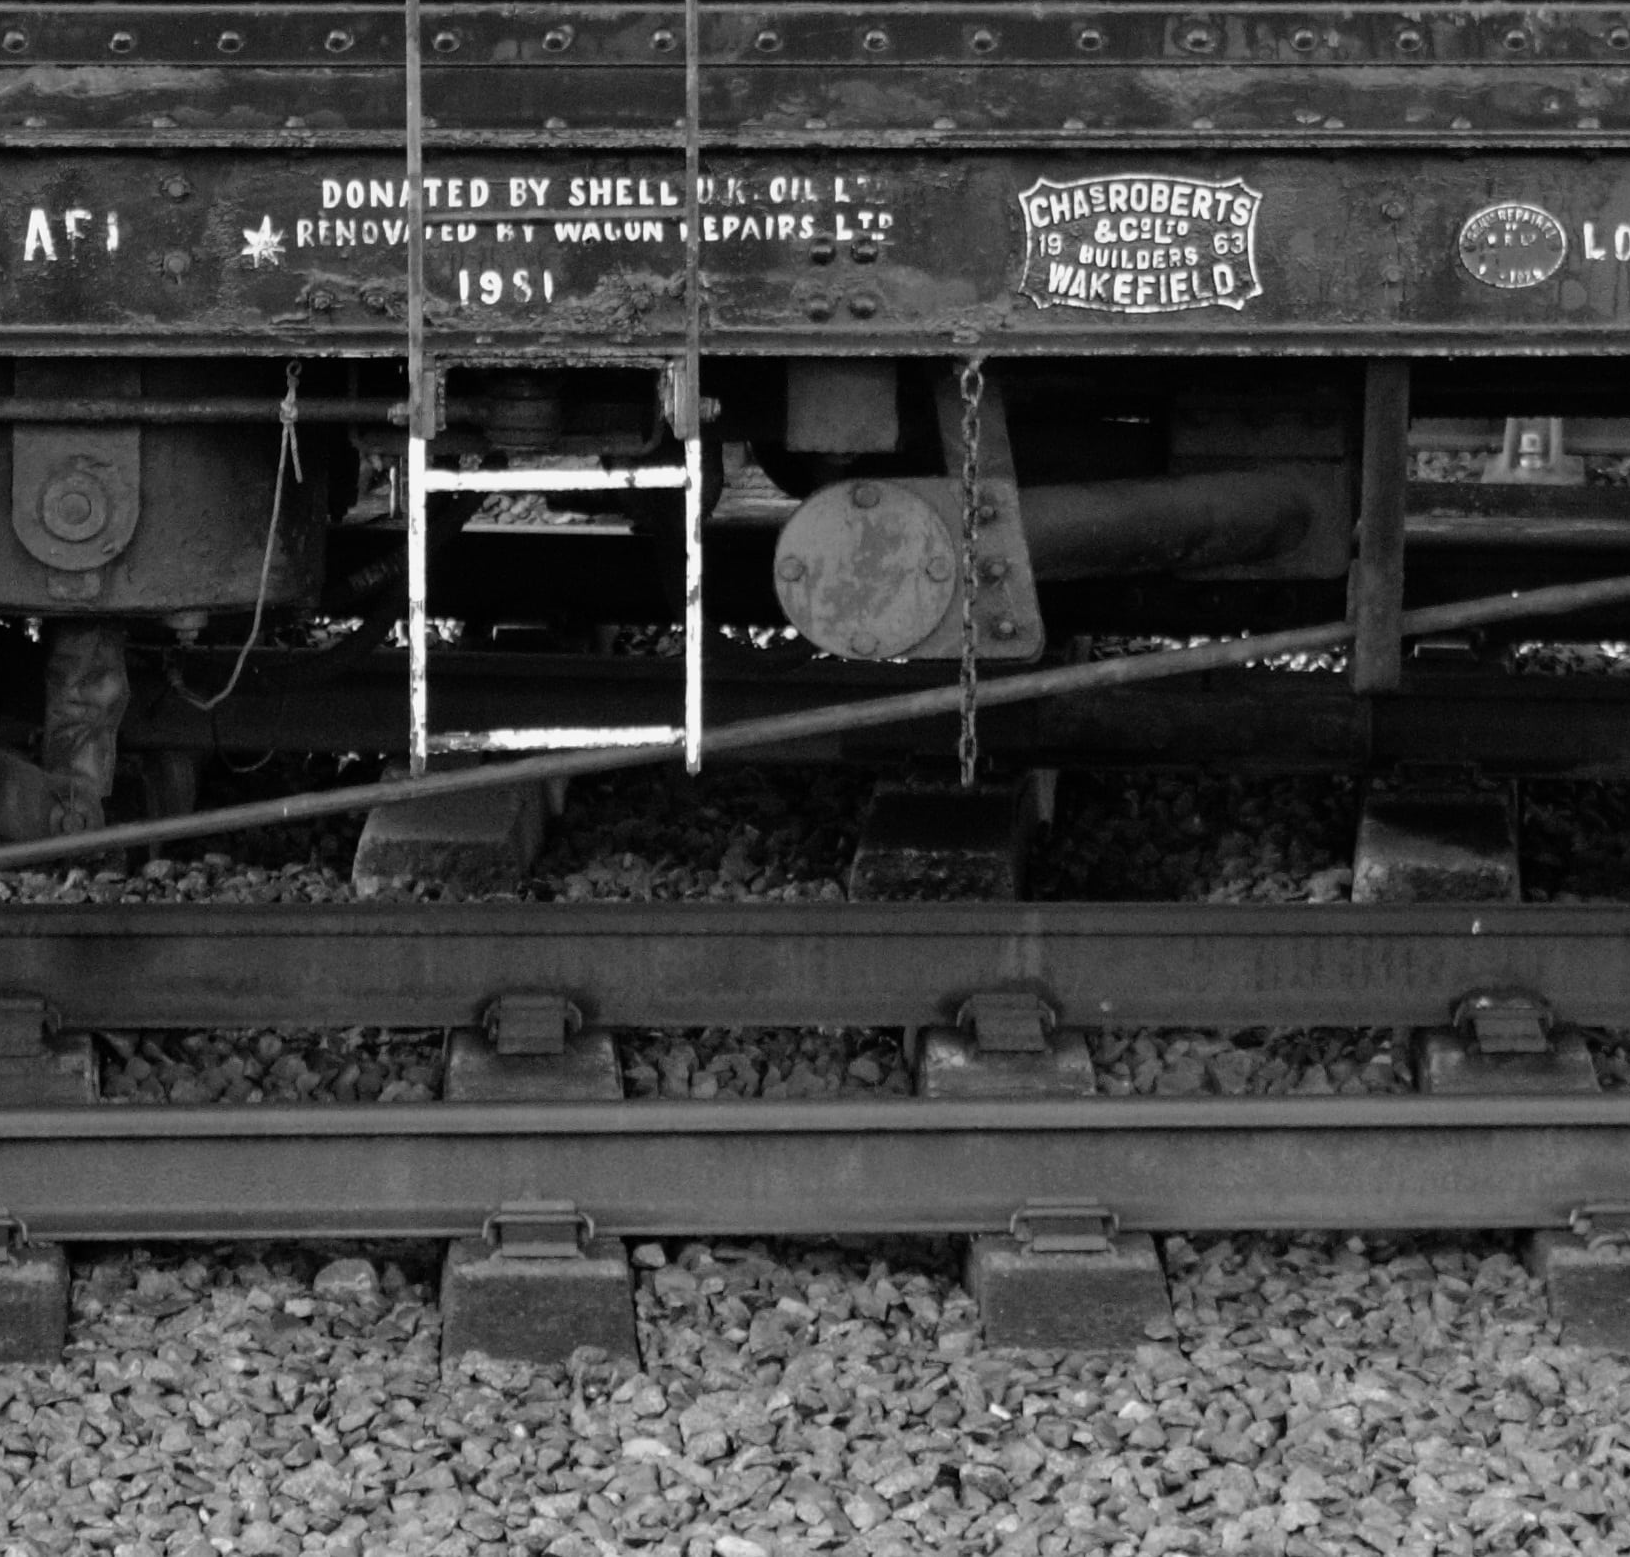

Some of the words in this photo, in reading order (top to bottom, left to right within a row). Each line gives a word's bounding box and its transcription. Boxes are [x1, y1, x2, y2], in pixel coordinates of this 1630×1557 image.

[509, 177, 551, 207] BY
[569, 177, 679, 207] SHELL
[770, 177, 819, 205] OIL
[1108, 182, 1252, 227] ROBERTS
[296, 218, 477, 248] RENOVED
[1038, 233, 1063, 258] 19
[1078, 244, 1199, 270] BUILDERS
[1048, 261, 1235, 306] WAKEFIELD
